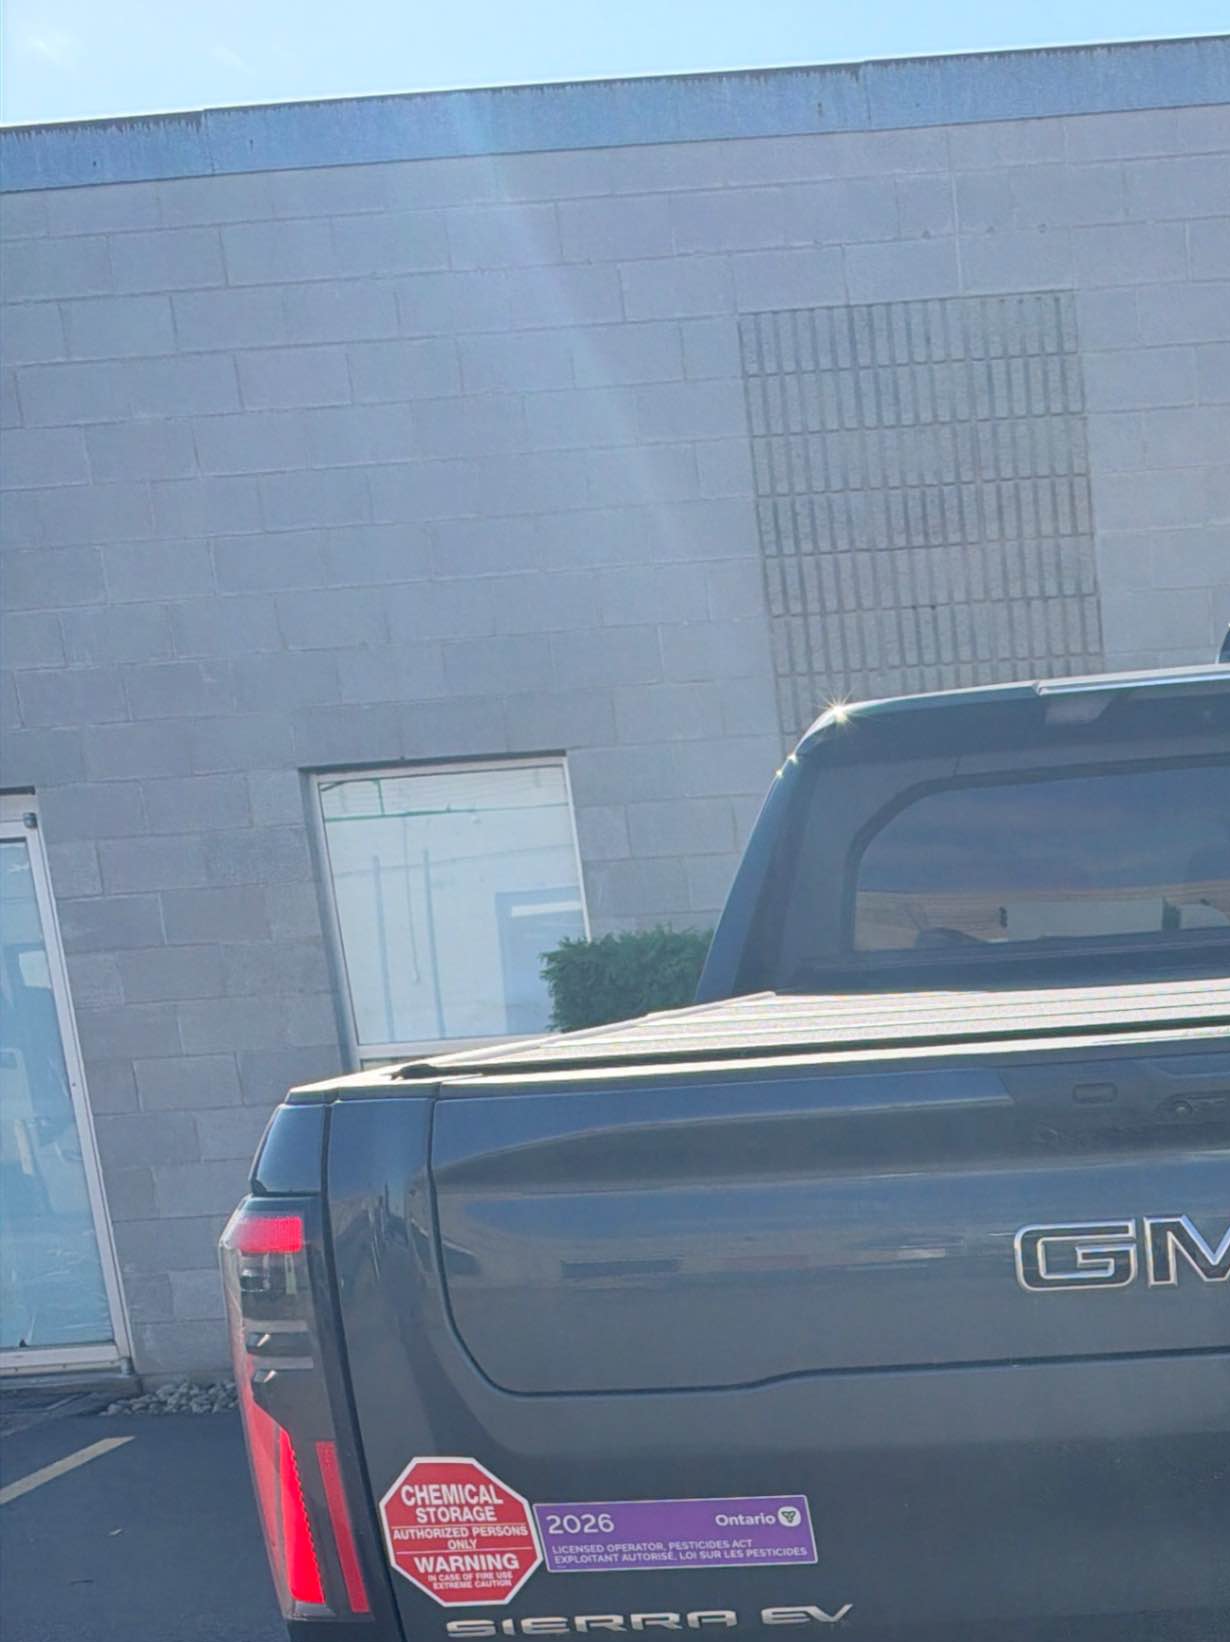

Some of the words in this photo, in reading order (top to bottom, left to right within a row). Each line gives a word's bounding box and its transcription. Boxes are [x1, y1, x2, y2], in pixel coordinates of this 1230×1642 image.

[400, 1483, 503, 1506] CHEMICAL
[416, 1506, 497, 1523] STORAGE
[715, 1512, 777, 1526] Ontario
[546, 1513, 615, 1534] 2026
[393, 1526, 469, 1540] AUTHORIZED
[472, 1525, 528, 1537] PERSONS
[447, 1539, 477, 1550] ONLY
[552, 1544, 605, 1554] LICENSED
[668, 1540, 730, 1551] PESTICIDES
[732, 1539, 752, 1549] ACT
[414, 1553, 519, 1573] WARNING
[554, 1553, 619, 1564] EXPLOITANT
[679, 1551, 697, 1560] LOI
[699, 1550, 721, 1559] SUR
[724, 1549, 744, 1558] LES
[746, 1546, 808, 1558] PESTICIDES
[438, 1573, 460, 1581] CASE
[475, 1572, 494, 1580] FIRE
[496, 1571, 513, 1579] USE
[433, 1581, 472, 1590] EXTREME
[446, 1610, 738, 1638] SIERRA
[760, 1603, 854, 1626] EV
